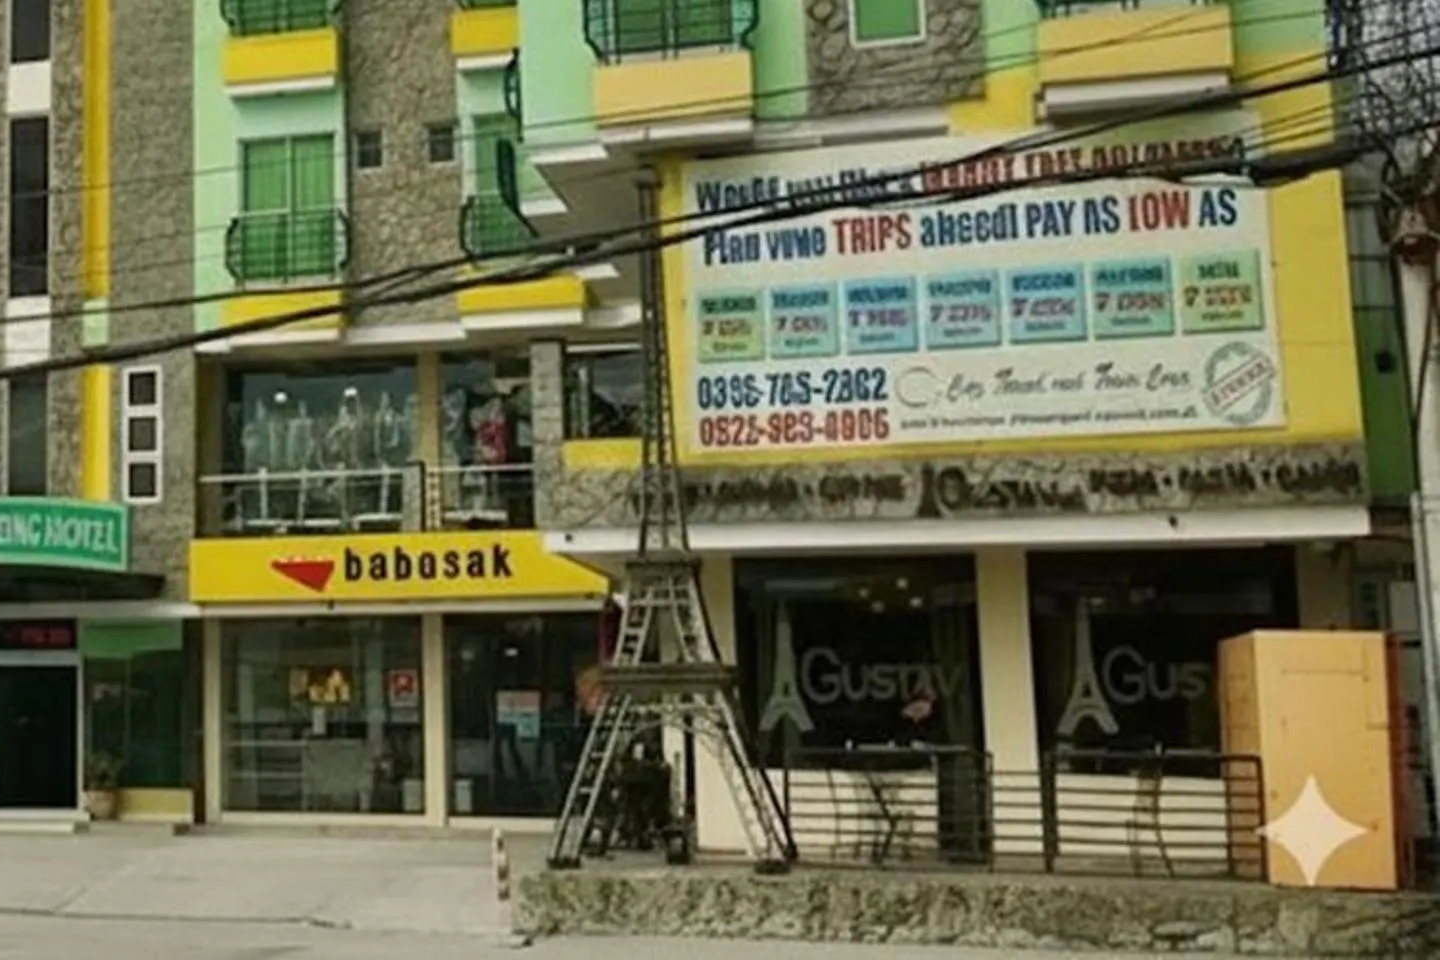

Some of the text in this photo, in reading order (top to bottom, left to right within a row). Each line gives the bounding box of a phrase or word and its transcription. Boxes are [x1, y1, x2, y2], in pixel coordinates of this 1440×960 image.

[831, 212, 912, 255] TRIPS
[1025, 200, 1077, 238] PAY
[1198, 188, 1237, 227] AS
